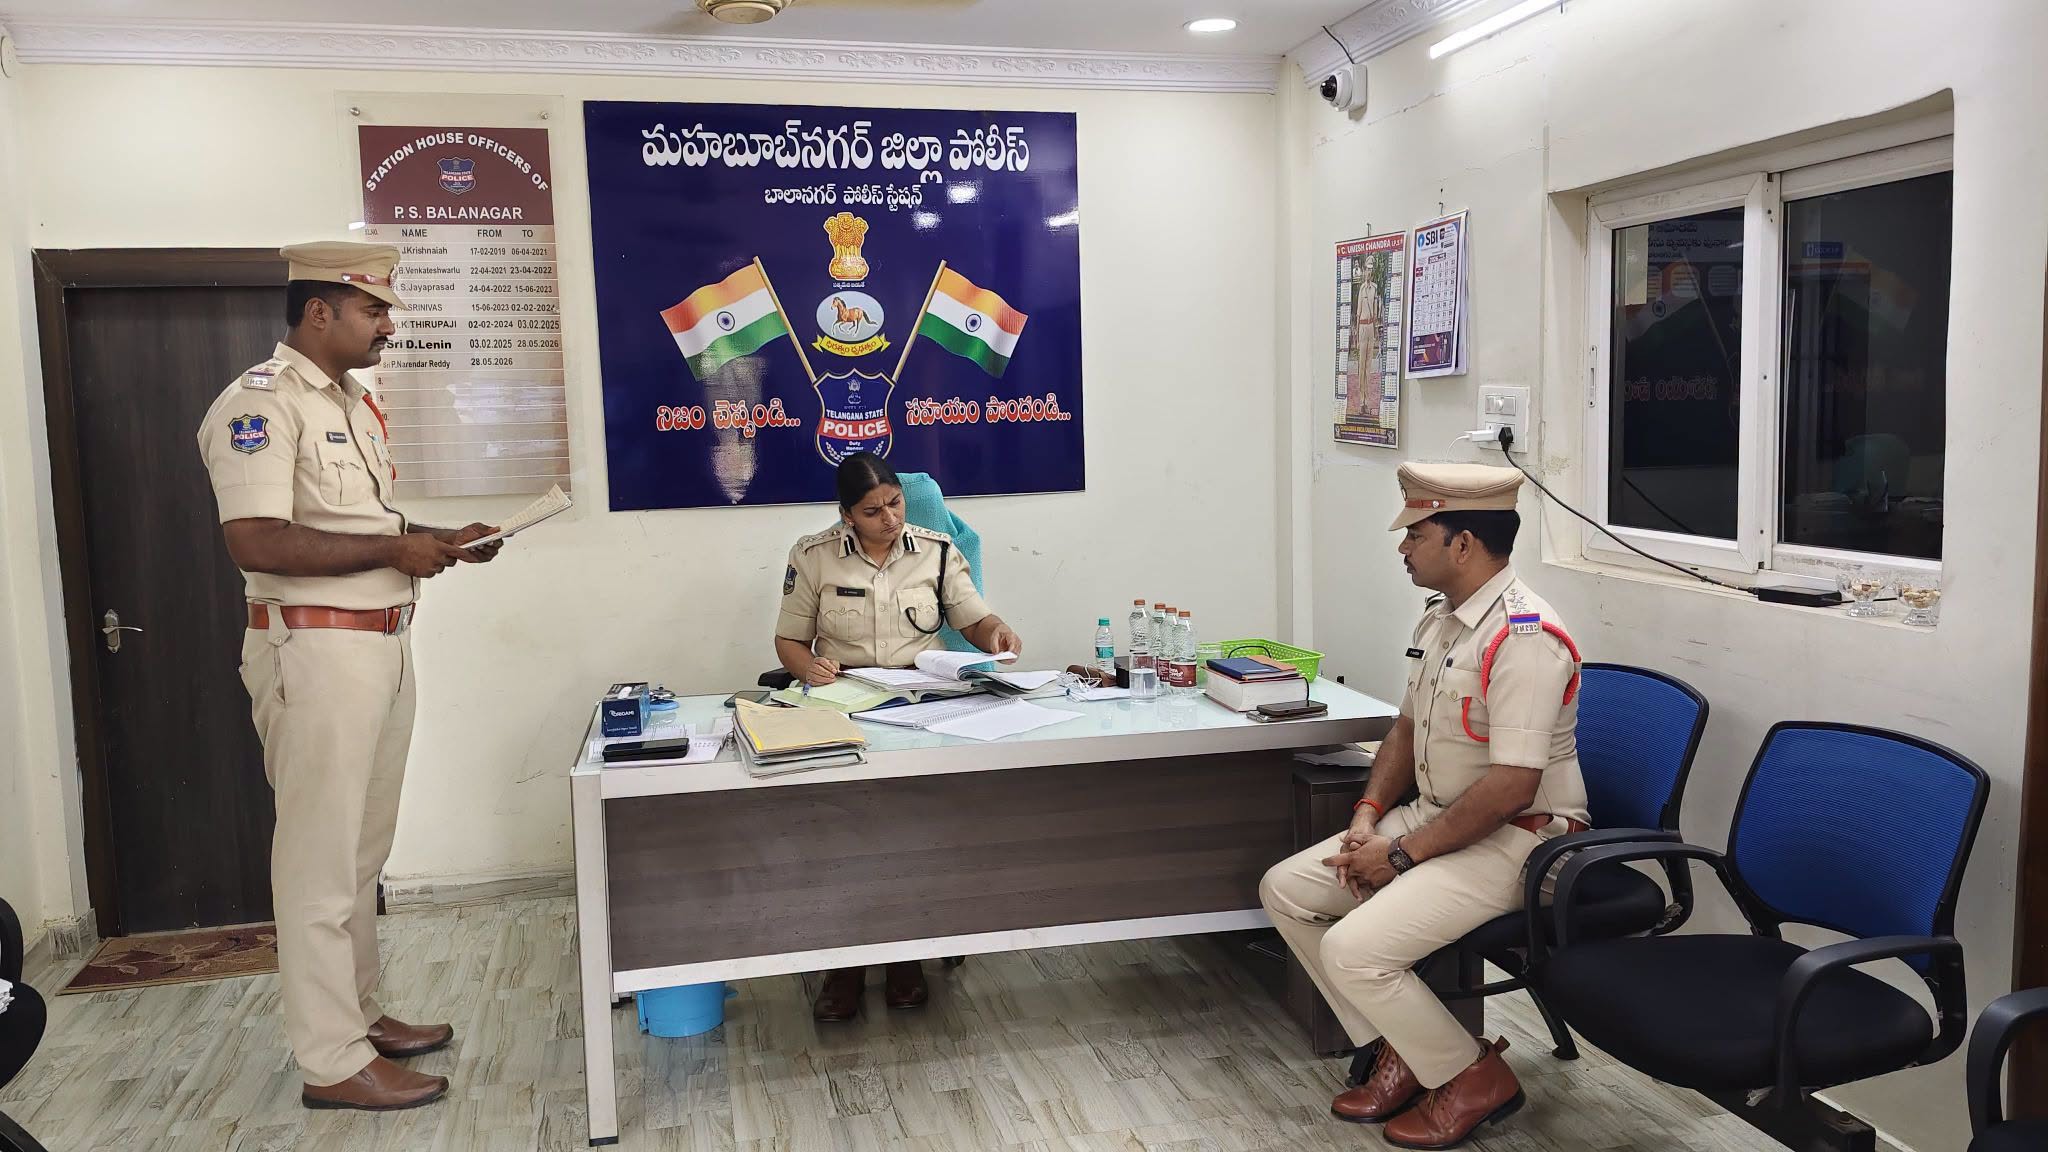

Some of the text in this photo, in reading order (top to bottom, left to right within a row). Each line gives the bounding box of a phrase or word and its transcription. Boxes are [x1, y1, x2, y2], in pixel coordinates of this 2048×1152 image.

[881, 132, 943, 183] జిల్లా
[949, 124, 1030, 171] పోలీస్
[366, 132, 549, 192] STATION HOUSE OFFICERS OF
[764, 183, 923, 211] బాలానగర్ పోలీస్ స్టేషన్
[394, 206, 523, 220] P. S. BALANAGAR
[401, 229, 428, 238] NAME
[477, 229, 502, 238] FROM
[522, 229, 534, 238] TO
[1425, 229, 1438, 246] SBI
[1366, 239, 1391, 250] CHANDRA
[470, 248, 506, 256] 17-02-2019
[470, 267, 507, 275] 22-04-2021
[510, 266, 552, 274] 23-04-2022
[469, 285, 512, 293] 24-04-2022
[515, 285, 553, 293] 15-06-2023
[468, 320, 513, 328] 02-02-2024
[517, 320, 560, 330] 03.02.2025
[386, 340, 403, 349] Sri
[406, 340, 452, 349] D.Lenin
[470, 339, 512, 349] 03.02.2025
[428, 360, 450, 369] Reddy
[656, 405, 706, 431] నిజం
[826, 409, 884, 420] TELANGANA STATE
[823, 420, 887, 437] POLICE
[234, 431, 265, 440] POLICE
